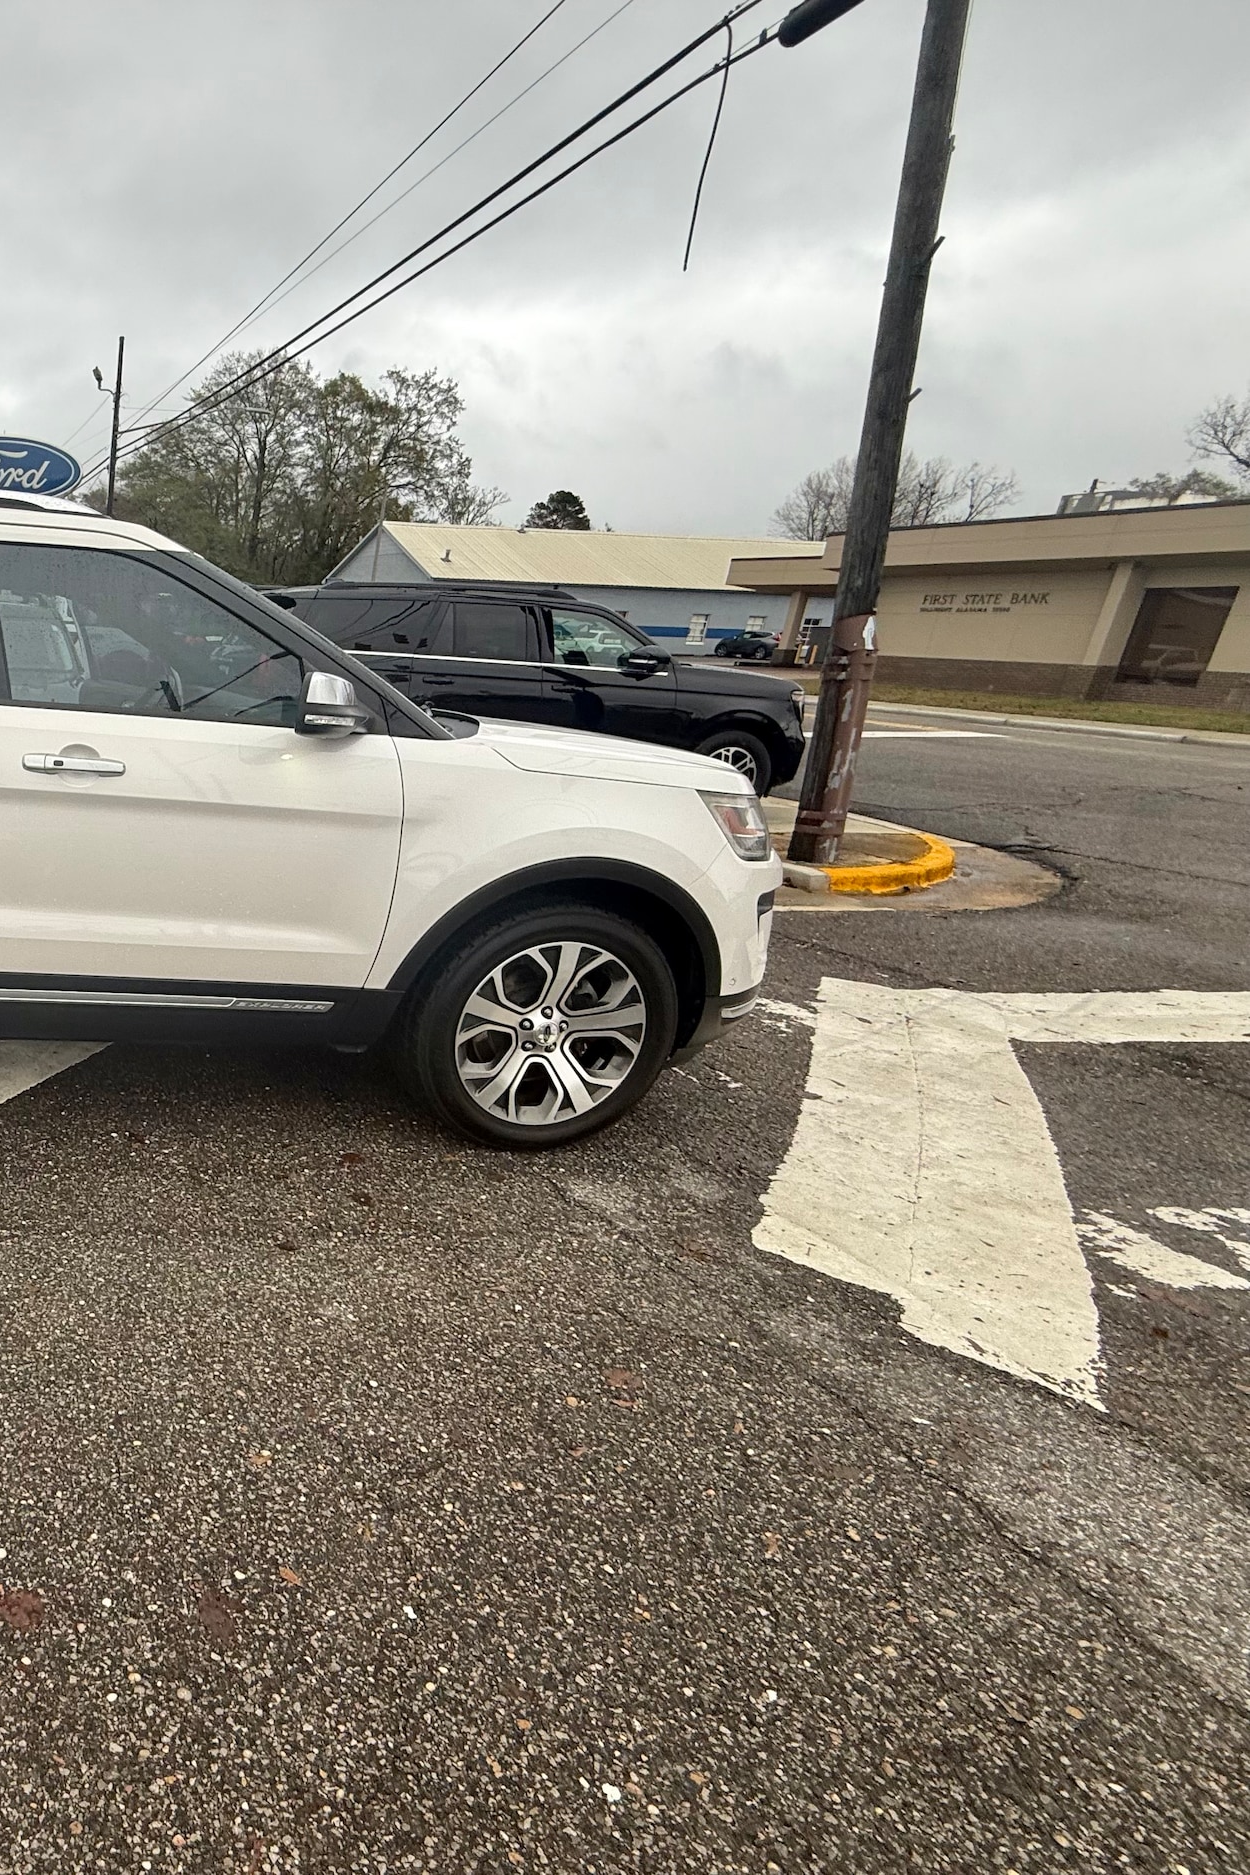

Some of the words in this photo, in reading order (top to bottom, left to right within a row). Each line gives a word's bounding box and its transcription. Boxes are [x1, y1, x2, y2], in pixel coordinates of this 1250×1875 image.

[922, 594, 957, 605] FIRST
[962, 593, 1003, 605] STATE
[1010, 592, 1050, 604] BANK
